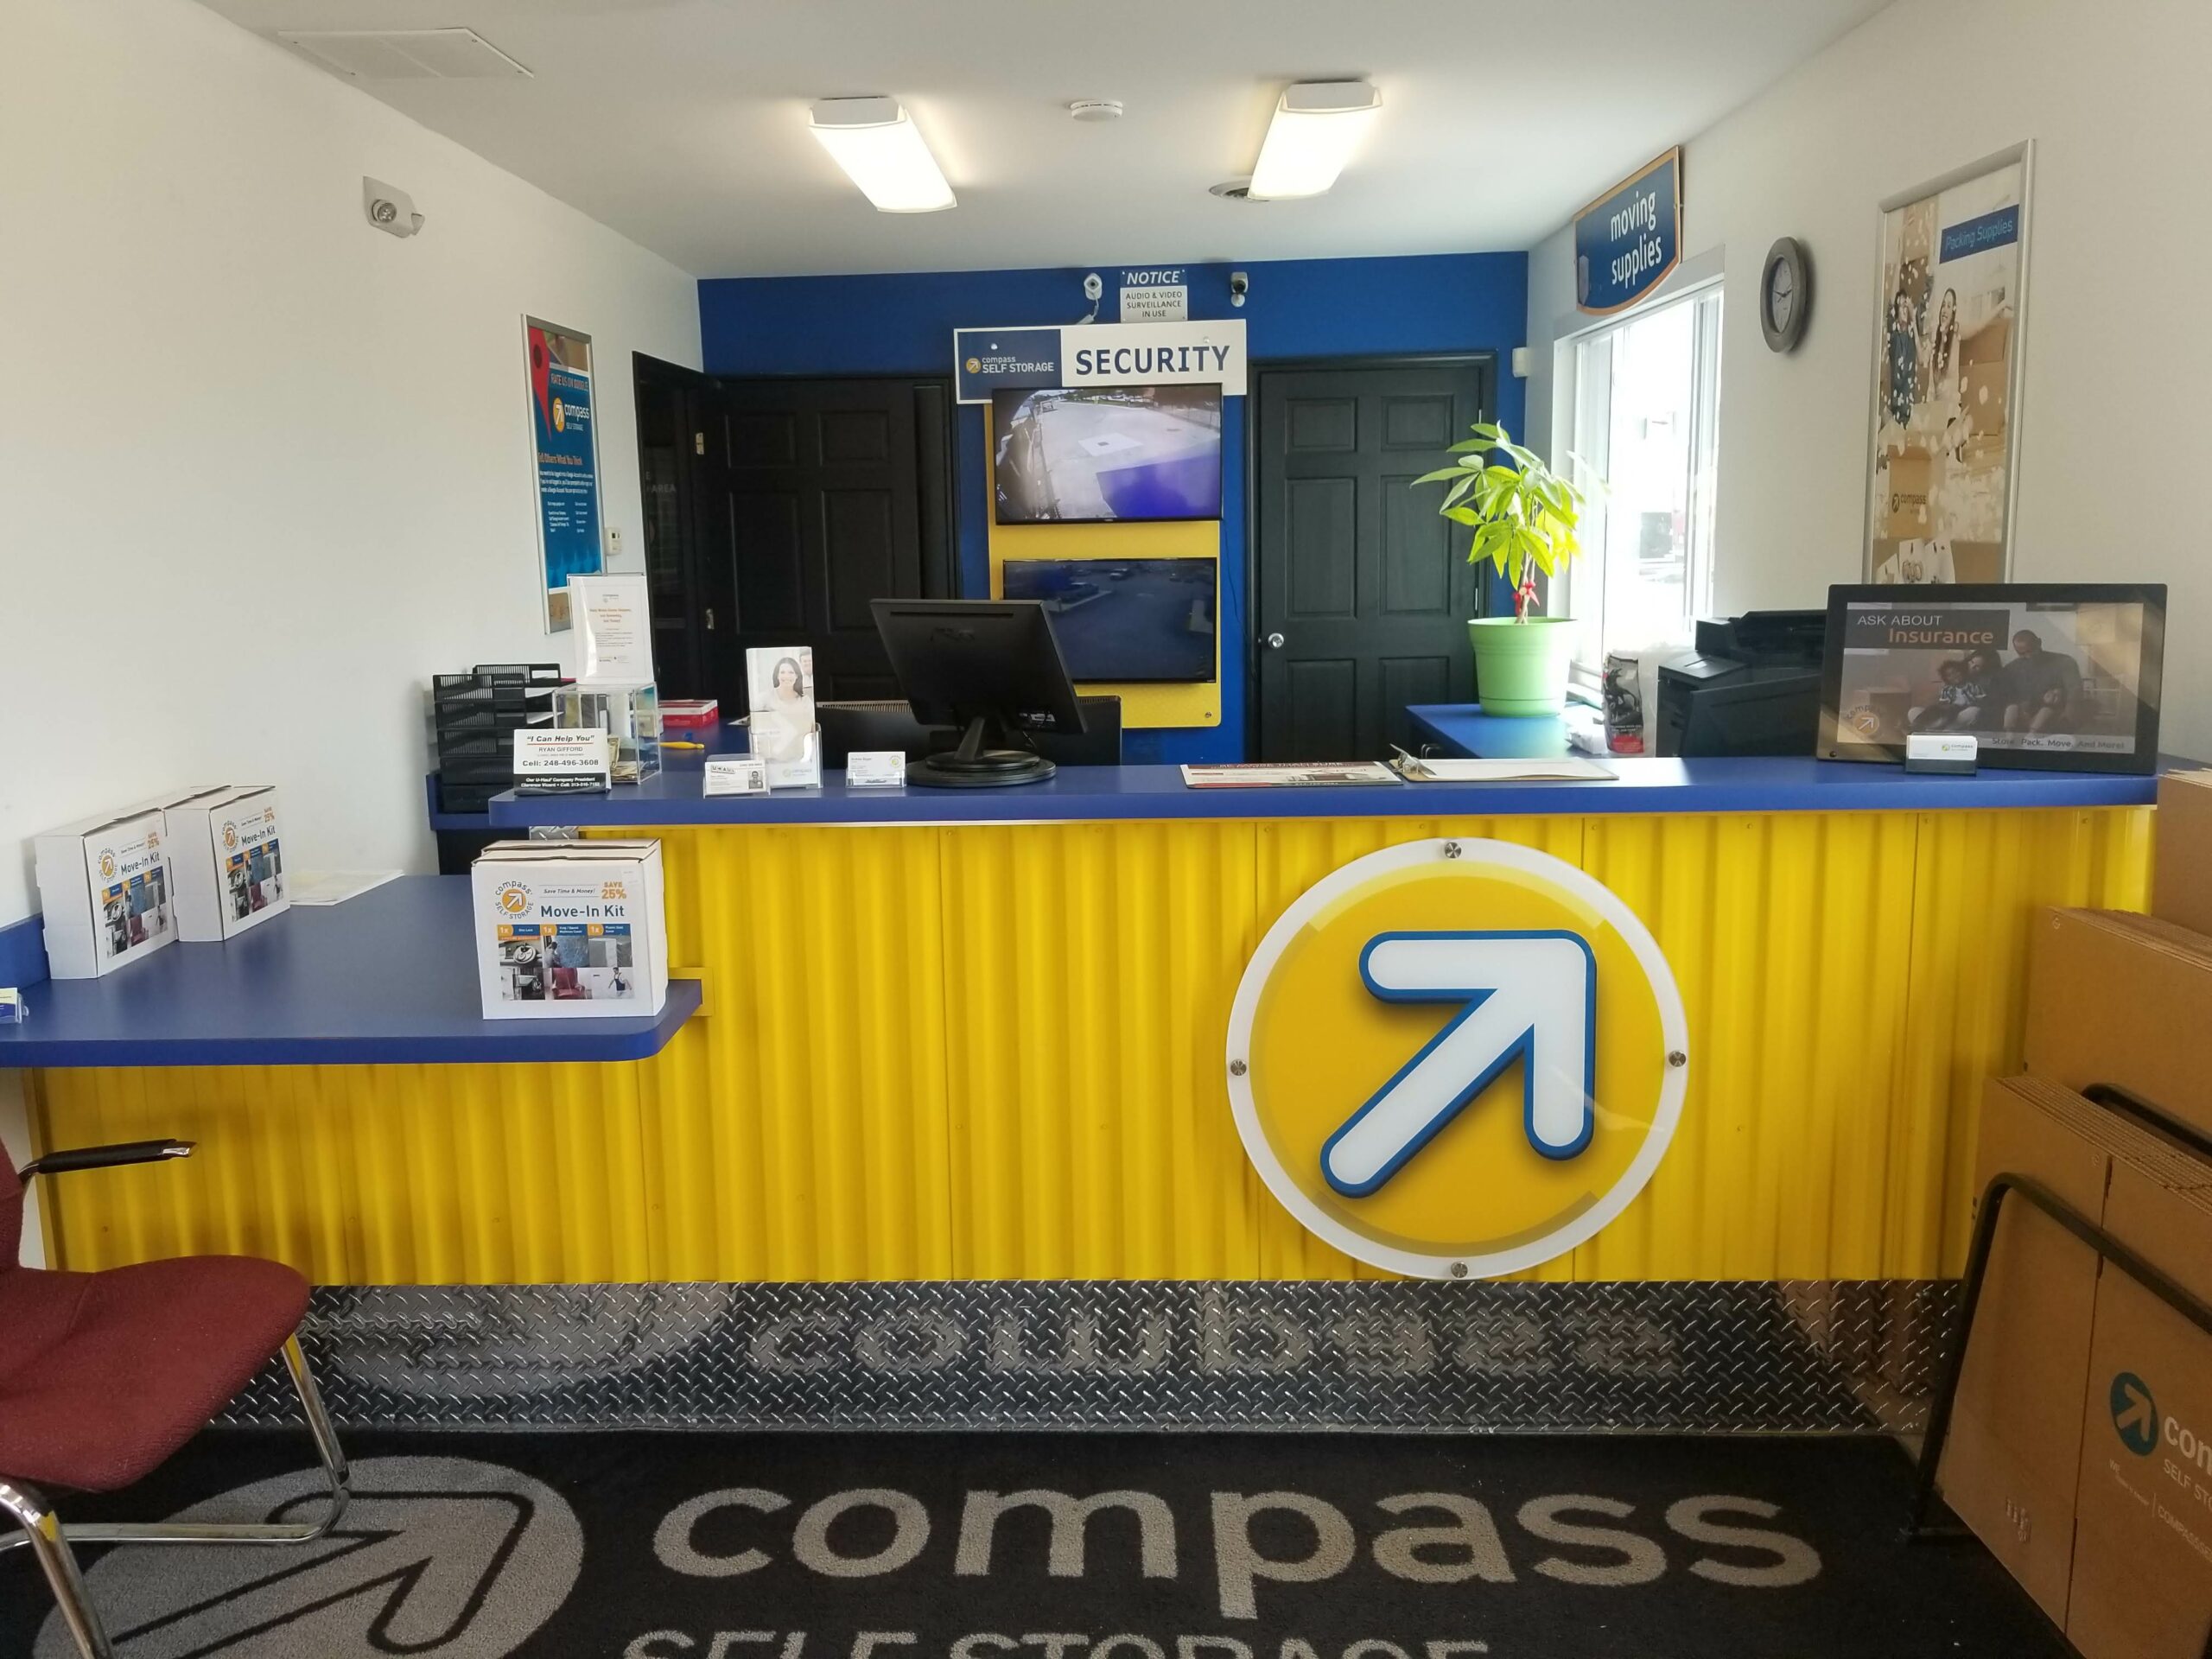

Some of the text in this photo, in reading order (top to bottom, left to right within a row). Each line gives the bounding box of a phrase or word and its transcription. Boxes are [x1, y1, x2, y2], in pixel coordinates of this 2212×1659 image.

[1611, 190, 1656, 242] moving
[1945, 219, 2012, 251] Packing Supplies
[1611, 232, 1662, 289] supplies
[1127, 270, 1179, 285] NOTICE
[1126, 292, 1149, 301] AUDIO
[1160, 290, 1182, 300] VIDEO
[1127, 300, 1182, 309] SURVEILLANCE
[1141, 309, 1166, 319] IN USE
[982, 356, 1016, 365] compass
[982, 362, 1054, 374] SELF STORAGE
[1076, 346, 1230, 375] SECURITY
[564, 404, 589, 422] compass
[1857, 615, 1942, 626] ASK ABOUT
[1888, 627, 1993, 645] Insurance
[241, 825, 276, 847] Move-In Kit
[121, 851, 160, 875] Move-In Kit
[601, 888, 626, 899] 25%
[495, 902, 534, 919] SELF STORAGE
[541, 905, 625, 918] Move-In Kit
[2163, 1459, 2191, 1489] SELF
[653, 1487, 1821, 1620] compass
